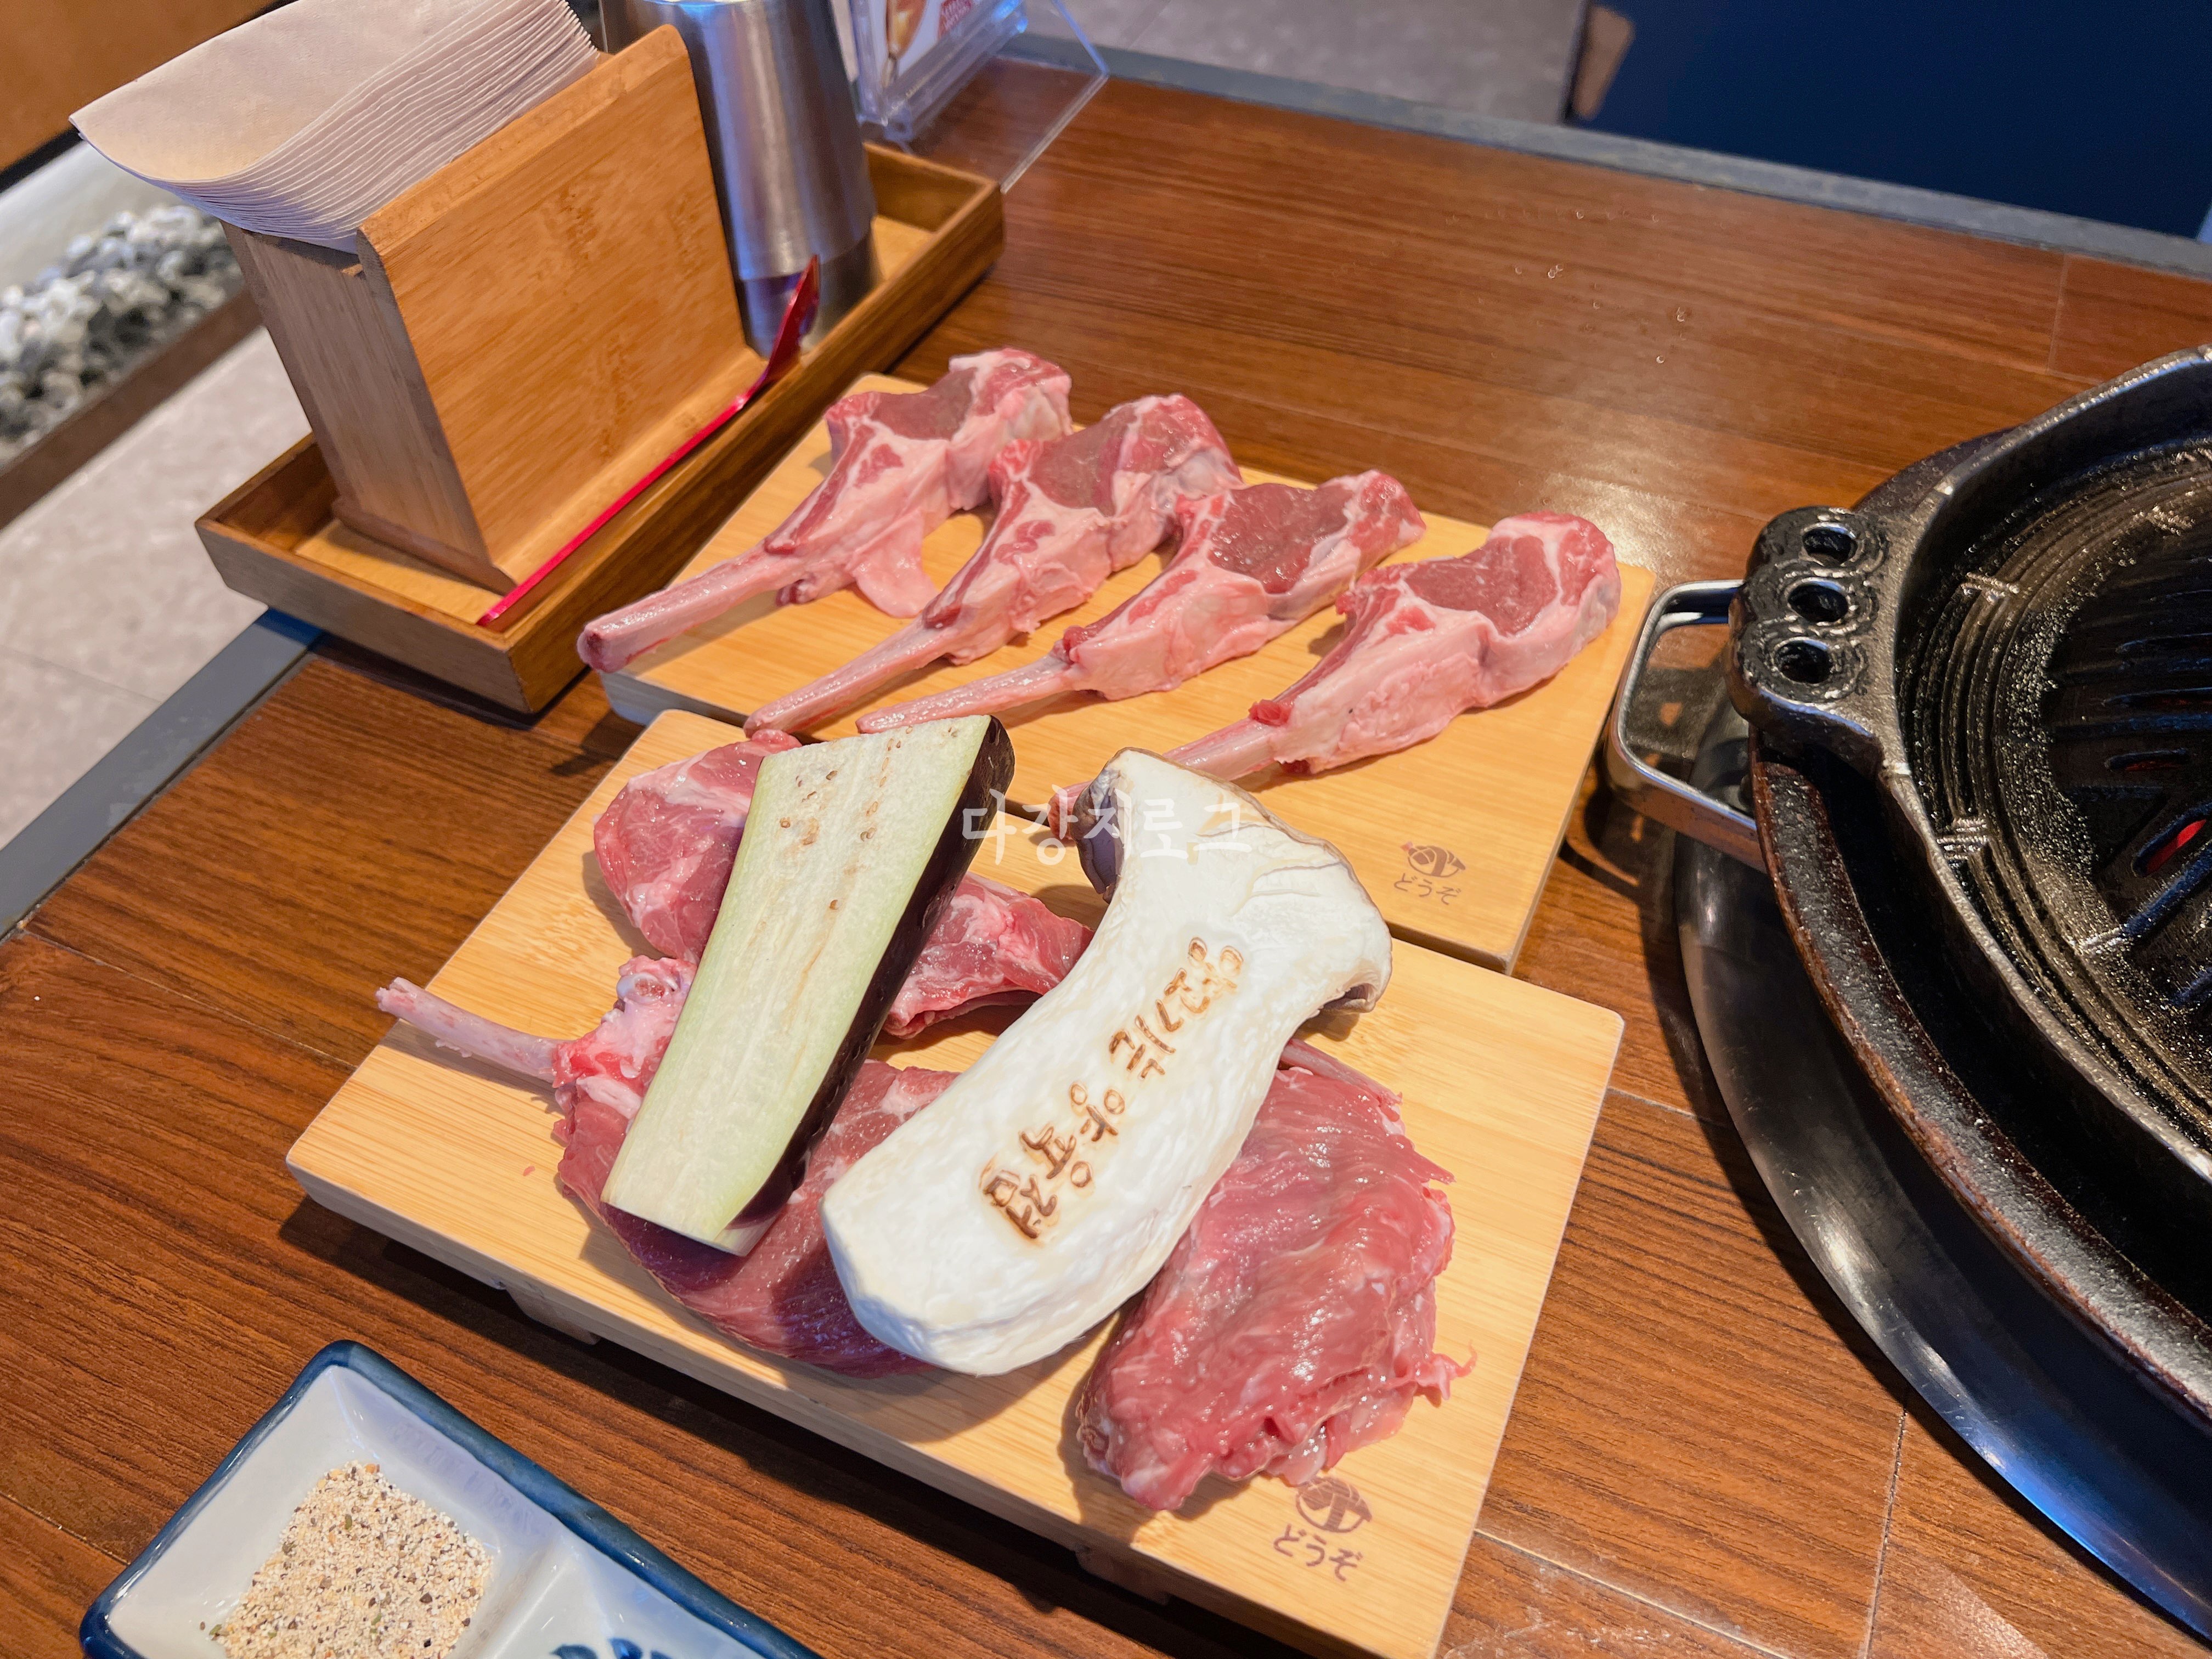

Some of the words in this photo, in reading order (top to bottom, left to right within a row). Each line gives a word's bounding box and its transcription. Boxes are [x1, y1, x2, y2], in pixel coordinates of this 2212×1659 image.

[1393, 873, 1462, 905] どうぞ
[1108, 936, 1244, 1079] 양고기는
[981, 1080, 1125, 1239] 양육점
[1273, 1523, 1363, 1582] どうぞ
